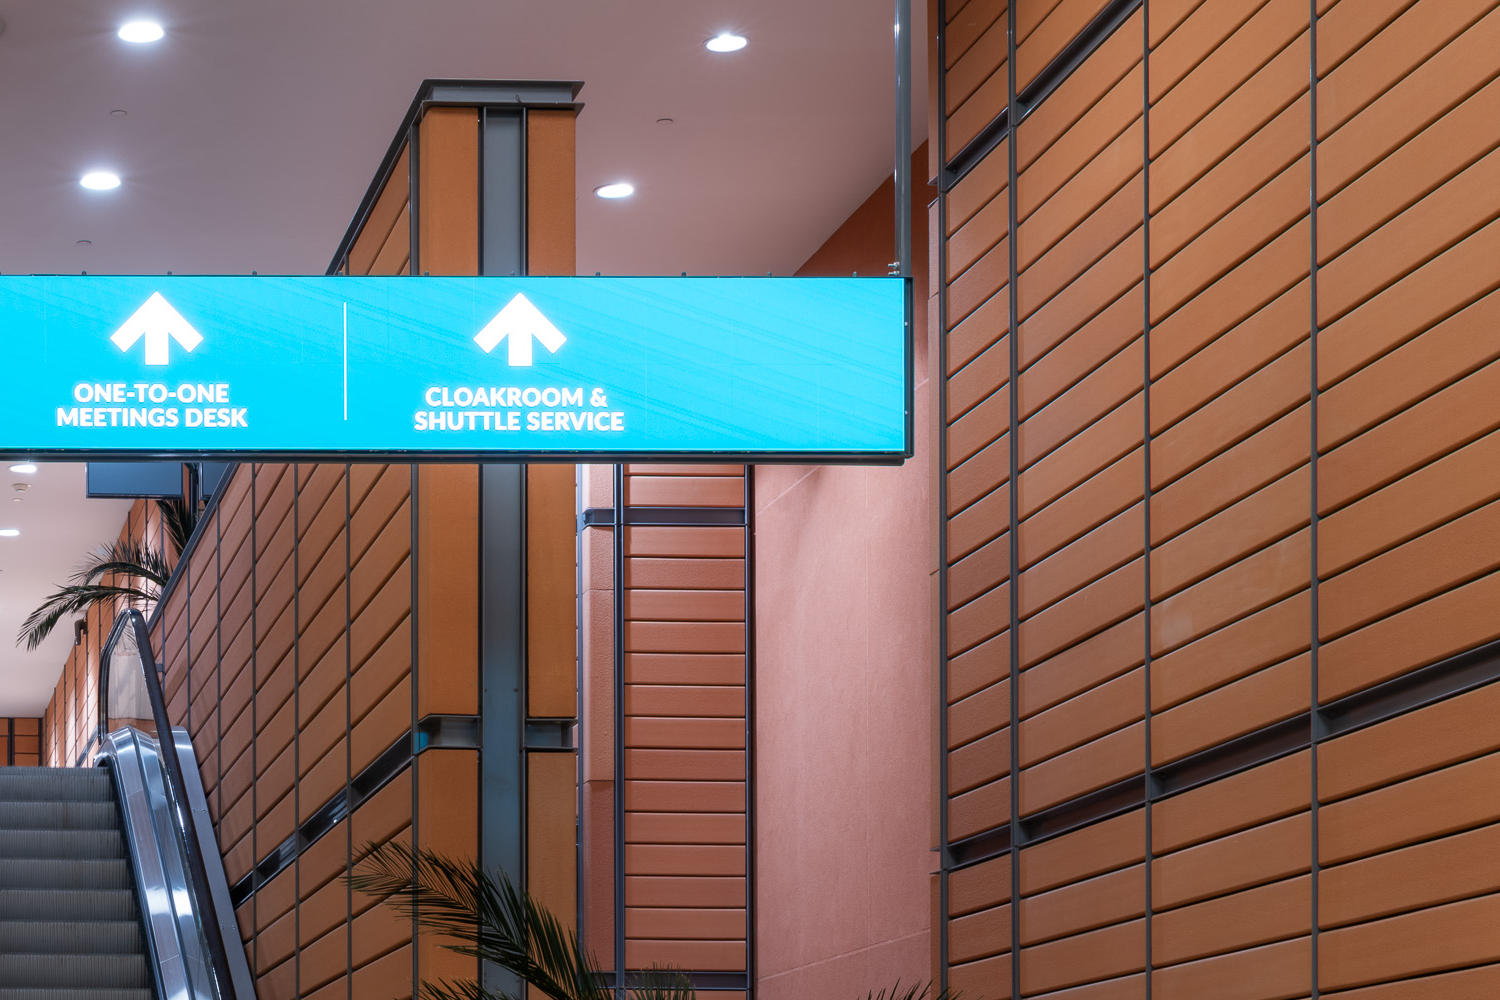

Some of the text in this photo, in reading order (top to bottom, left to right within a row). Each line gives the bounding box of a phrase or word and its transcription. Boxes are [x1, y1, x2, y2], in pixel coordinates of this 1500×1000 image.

[74, 383, 230, 404] ONE-TO-ONE
[424, 386, 608, 408] CLOAKROOM &
[56, 407, 249, 428] MEETINGS DESK
[414, 410, 625, 432] SHUTTLE SERVICE
